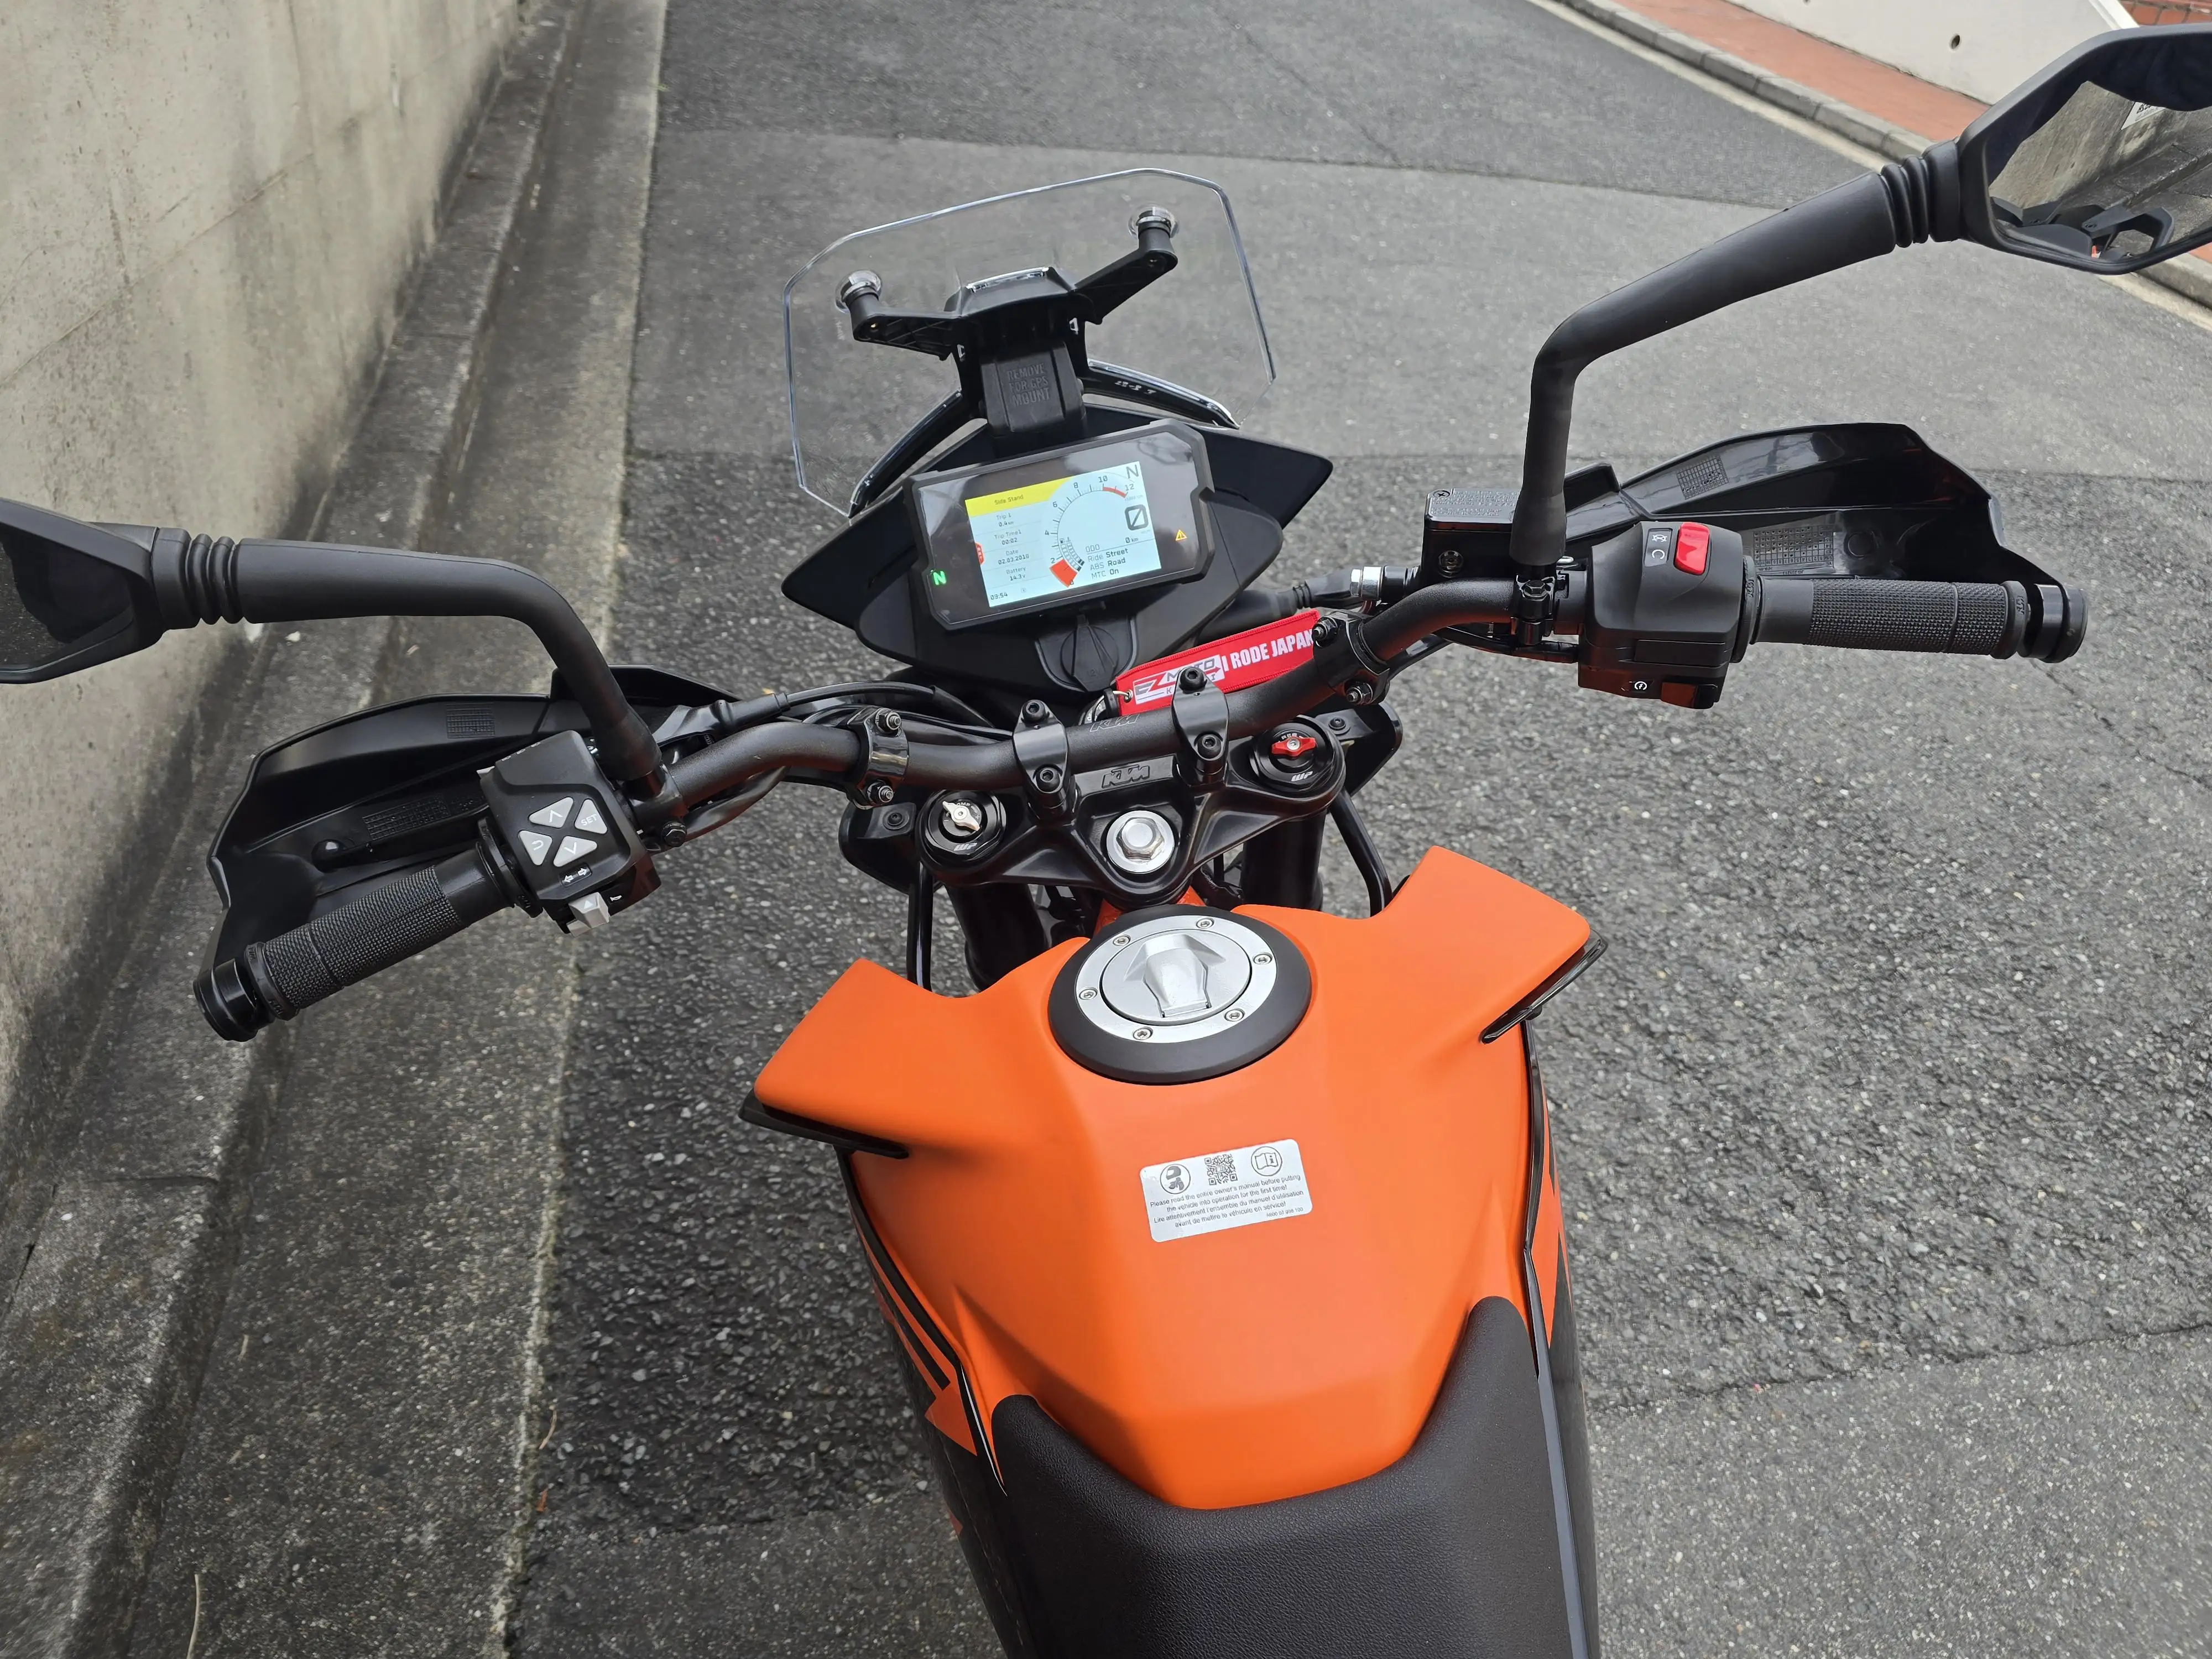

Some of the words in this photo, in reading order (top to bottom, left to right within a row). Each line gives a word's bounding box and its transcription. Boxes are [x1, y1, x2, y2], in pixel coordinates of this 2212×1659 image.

[1007, 363, 1045, 380] REMOVE
[1009, 380, 1027, 392] FOR
[1030, 376, 1048, 388] GPS
[1013, 388, 1050, 406] MOUNT
[1126, 464, 1139, 479] N
[1088, 554, 1103, 562] Ride
[1106, 548, 1128, 558] Street
[1006, 566, 1026, 575] Battery
[1090, 562, 1104, 571] ABS
[1108, 557, 1126, 567] Road
[933, 571, 947, 585] N
[1091, 571, 1106, 580] MTC
[990, 592, 1008, 601] 09:54
[1221, 656, 1229, 672] I
[1230, 643, 1270, 669] RODE
[1271, 628, 1313, 658] JAPAN
[1089, 713, 1140, 733] KTM
[1102, 764, 1150, 789] KTM
[1291, 771, 1313, 782] WP
[581, 813, 597, 826] SET
[953, 842, 978, 851] WP
[1150, 1199, 1170, 1207] Please
[1197, 1190, 1213, 1198] entire
[1214, 1185, 1237, 1195] owner's
[1239, 1181, 1260, 1191] manual
[1281, 1174, 1301, 1183] putting
[1177, 1201, 1198, 1210] vehicle
[1212, 1194, 1239, 1204] operation
[1272, 1184, 1287, 1192] time!
[1166, 1208, 1206, 1221] attentivement
[1207, 1202, 1238, 1213] l'ensemble
[1249, 1196, 1270, 1204] manuel
[1271, 1190, 1304, 1201] d'utilisation
[1229, 1207, 1253, 1217] véhicule
[1262, 1201, 1286, 1211] service!
